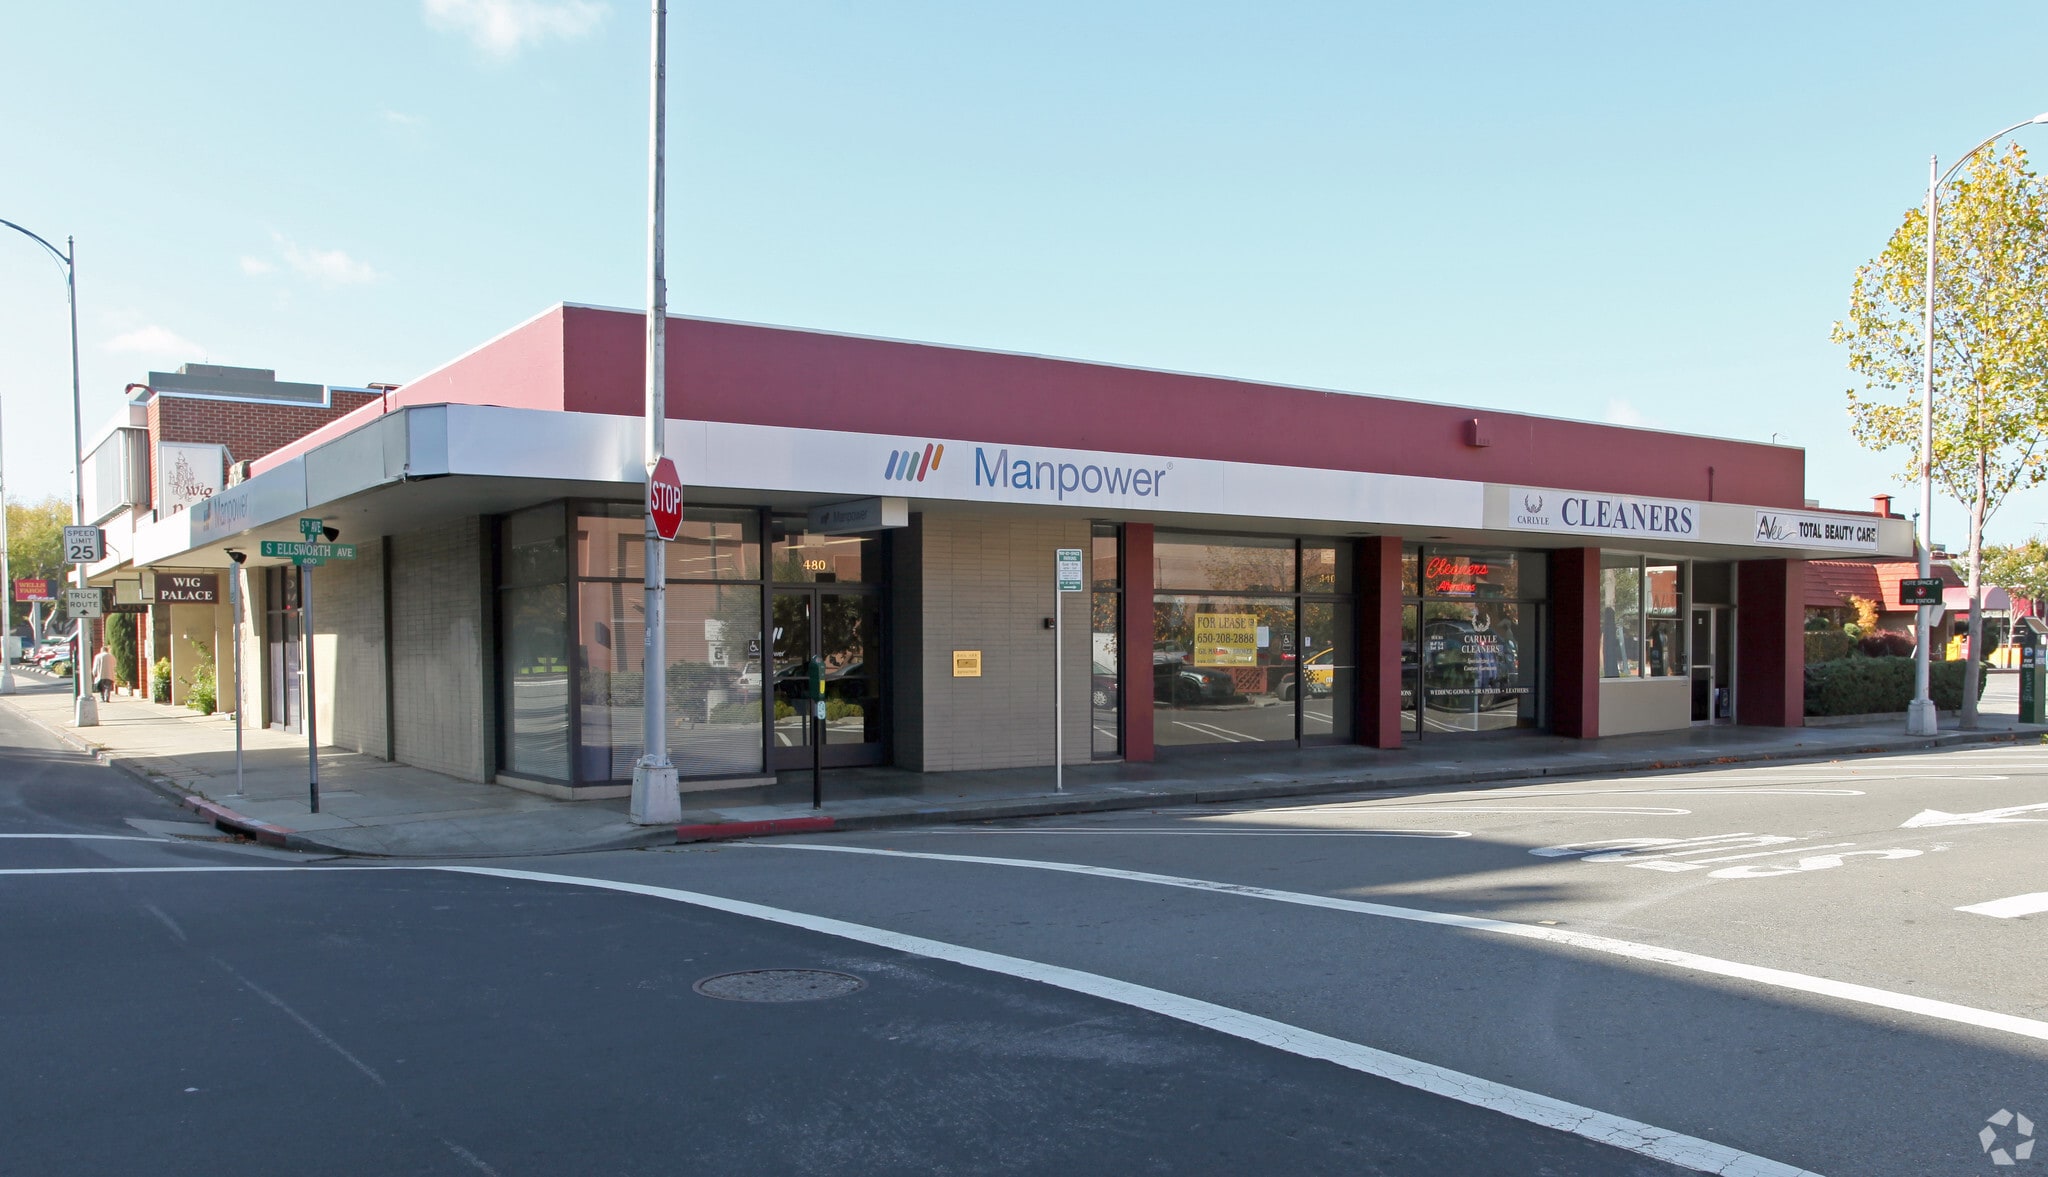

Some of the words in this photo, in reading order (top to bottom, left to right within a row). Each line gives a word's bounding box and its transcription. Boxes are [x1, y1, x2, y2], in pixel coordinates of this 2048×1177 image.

[975, 447, 1166, 501] Manpower
[186, 483, 213, 498] Wig
[652, 480, 681, 515] STOP
[214, 494, 249, 531] Manpower
[1561, 497, 1692, 534] CLEANERS
[311, 520, 321, 533] AVE
[1517, 515, 1550, 526] CARLYLE
[67, 529, 95, 537] SPEED
[1799, 522, 1822, 539] TOTAL
[1825, 524, 1854, 541] BEAUTY
[1856, 526, 1876, 542] CARE
[70, 545, 94, 560] 25
[266, 542, 272, 554] S
[277, 543, 331, 557] ELLSWORTH
[337, 547, 353, 557] AVE
[803, 559, 826, 570] 480
[1426, 557, 1489, 578] Cleaners
[172, 577, 201, 587] WIG
[161, 590, 213, 601] PALACE
[1197, 617, 1216, 629] FOR
[1219, 617, 1247, 629] LEASE
[1197, 633, 1255, 644] 650-208-2888
[1464, 634, 1498, 644] CARLYLE
[1461, 644, 1500, 654] CLEANERS
